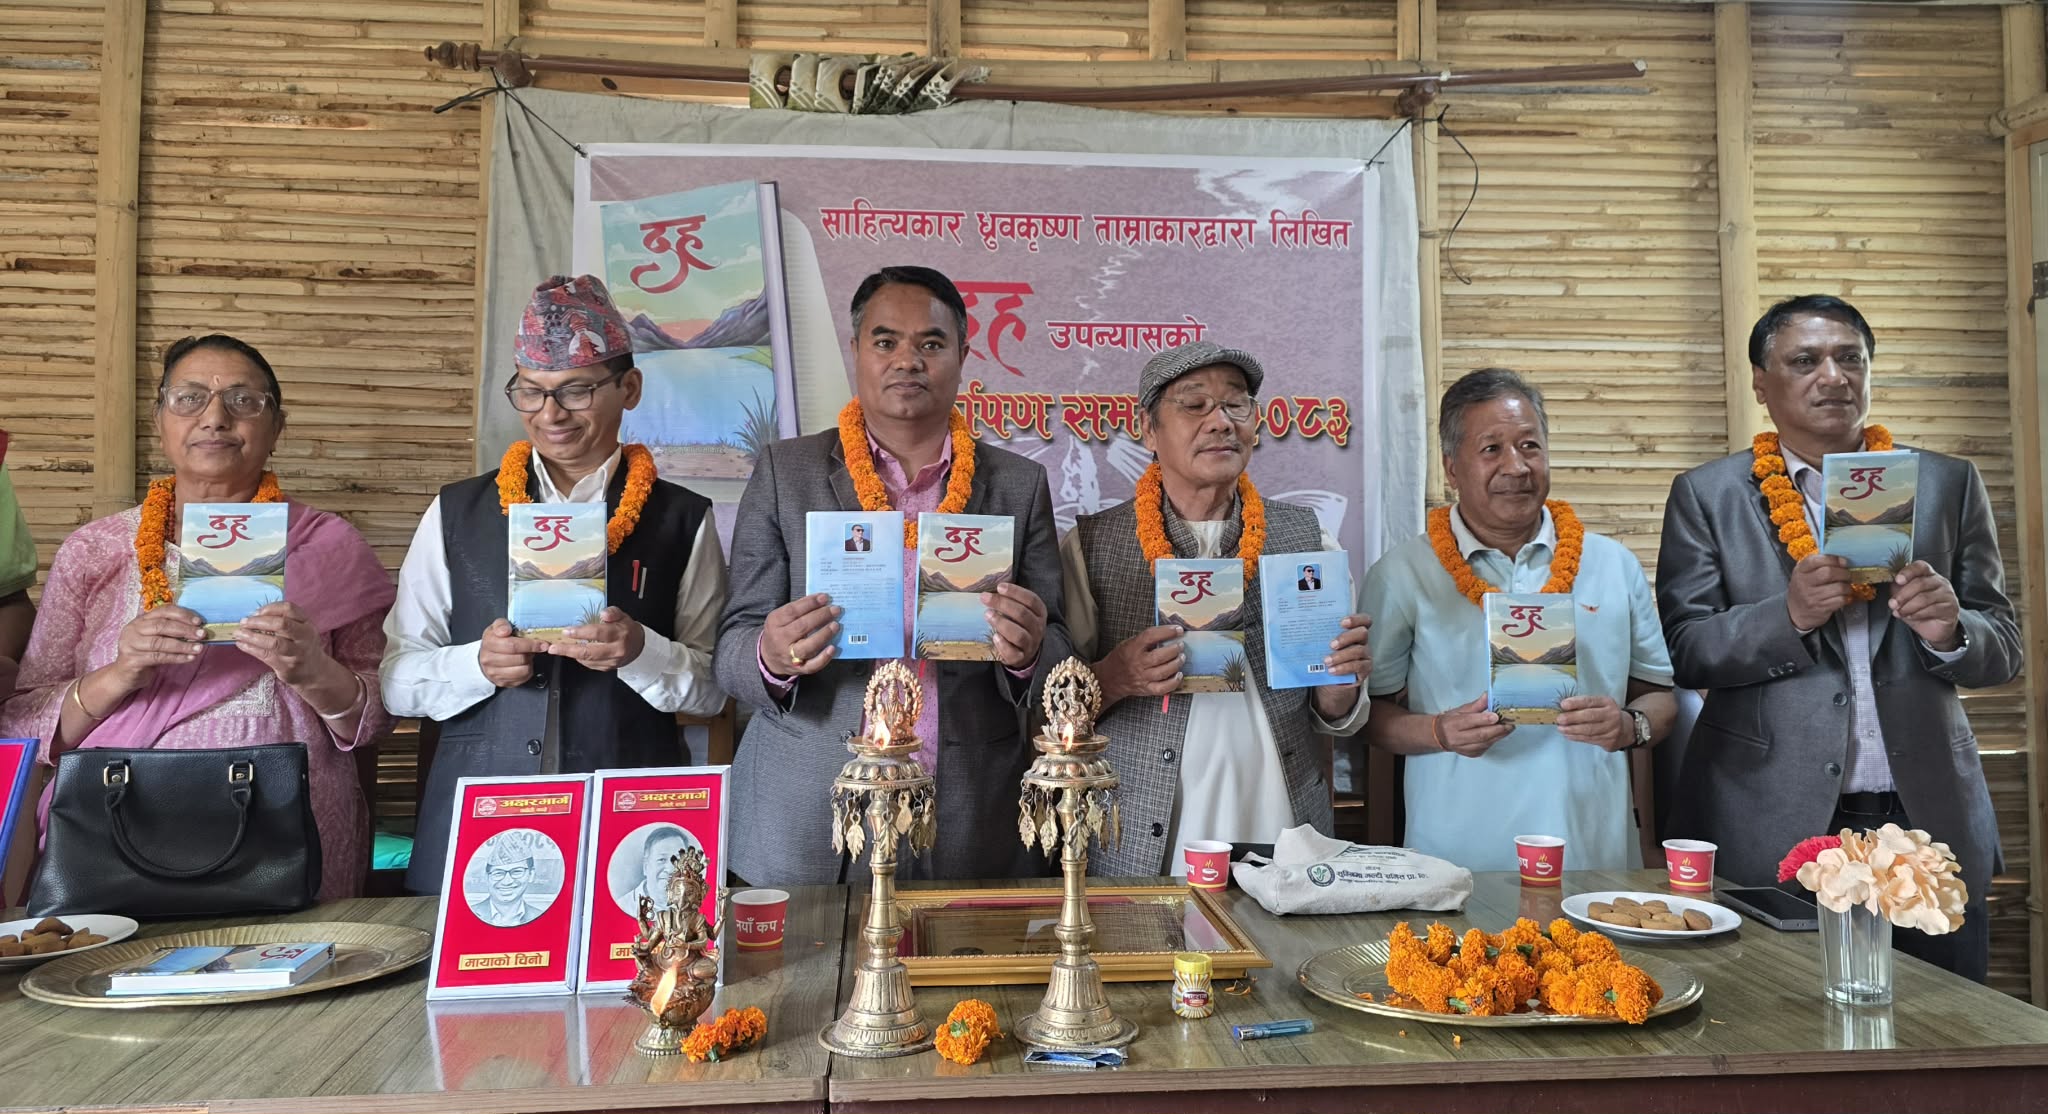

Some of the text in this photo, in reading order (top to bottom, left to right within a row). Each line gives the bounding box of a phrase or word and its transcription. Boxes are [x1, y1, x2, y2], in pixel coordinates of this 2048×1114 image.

[820, 198, 1353, 252] साहित्यकार ध्रुवकृष्ण ताम्राकारद्वारा लिखित
[630, 215, 721, 294] दह
[1046, 314, 1208, 353] उपन्यासको
[1254, 396, 1352, 446] ०८३
[1840, 467, 1887, 500] दह
[197, 515, 254, 549] दह
[523, 516, 576, 551] दह
[934, 526, 985, 563] दह
[1170, 571, 1216, 605] दह
[1501, 605, 1548, 638] दह
[464, 952, 544, 967] मायाको चिनो
